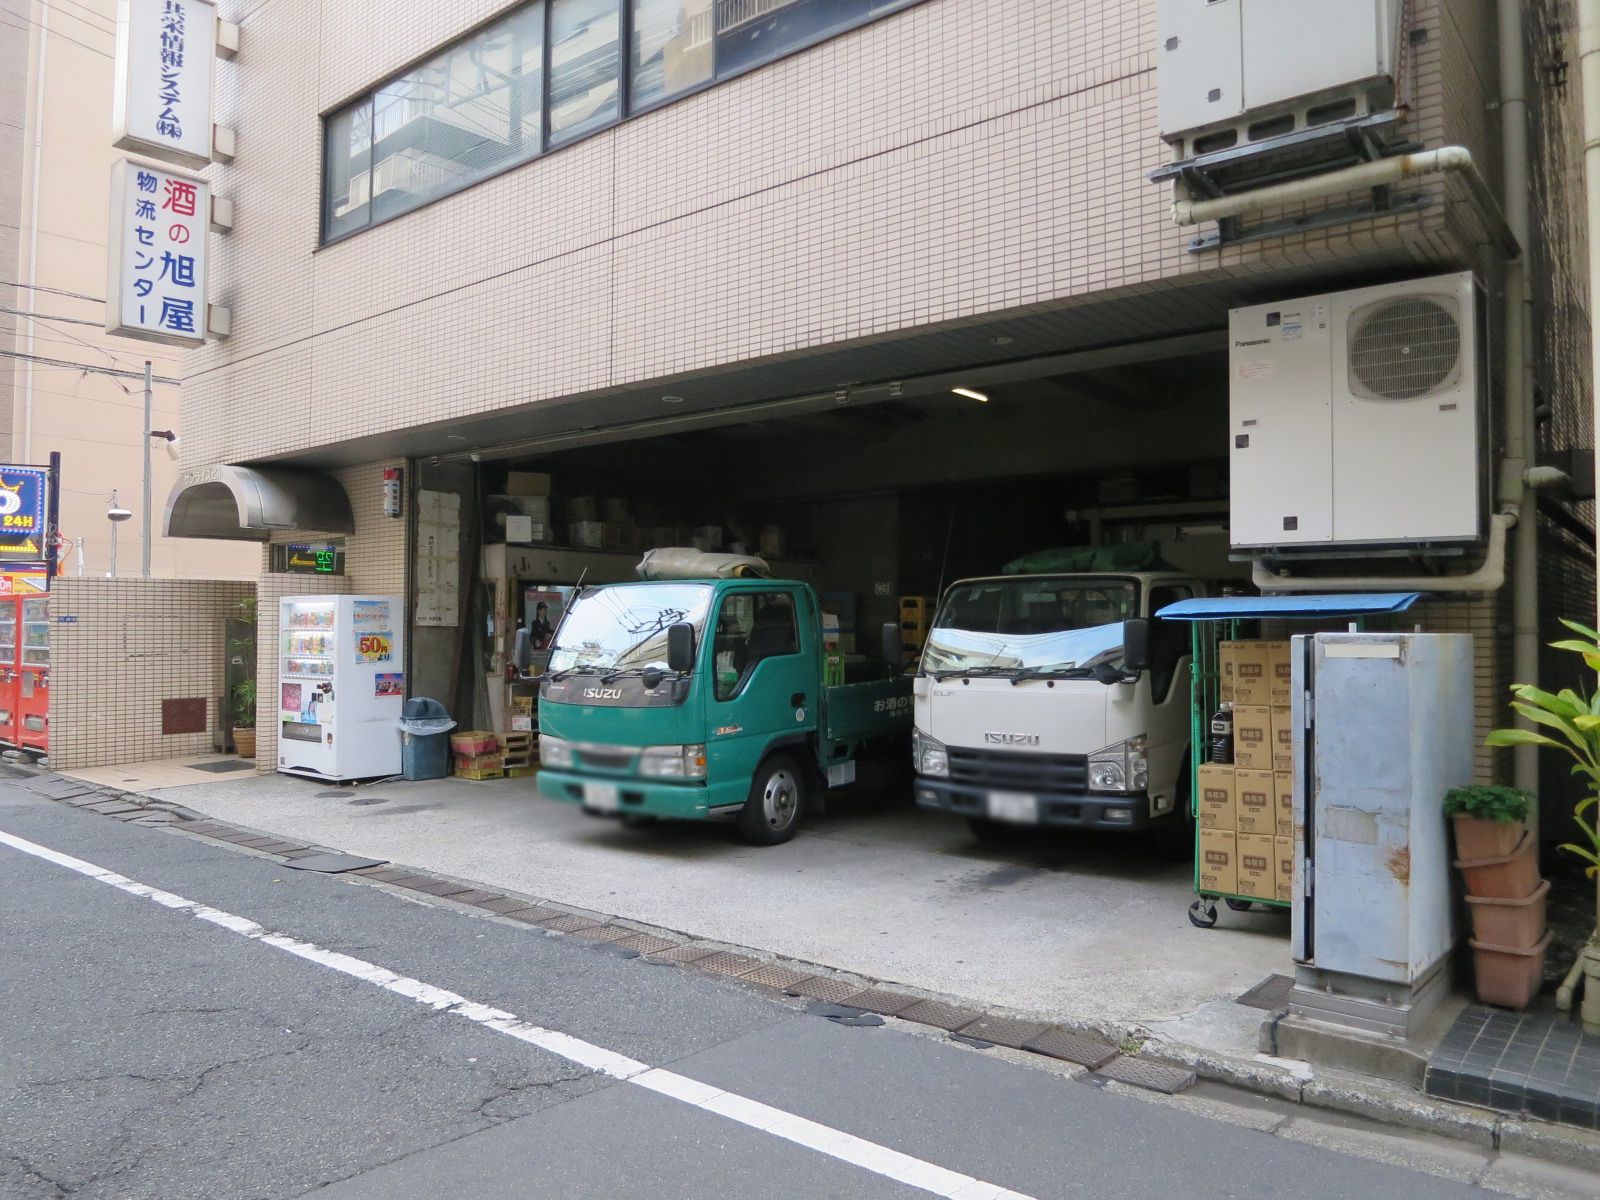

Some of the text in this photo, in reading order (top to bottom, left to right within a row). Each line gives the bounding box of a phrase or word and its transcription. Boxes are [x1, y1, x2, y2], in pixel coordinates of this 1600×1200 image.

[134, 171, 158, 324] 物流センター
[158, 178, 198, 333] 酒の旭屋
[1235, 338, 1271, 347] Panasonic
[3, 514, 33, 527] 24H
[360, 636, 388, 654] 50円
[377, 653, 390, 662] より
[583, 688, 622, 699] ISUZU
[984, 731, 1040, 747] ISUZU
